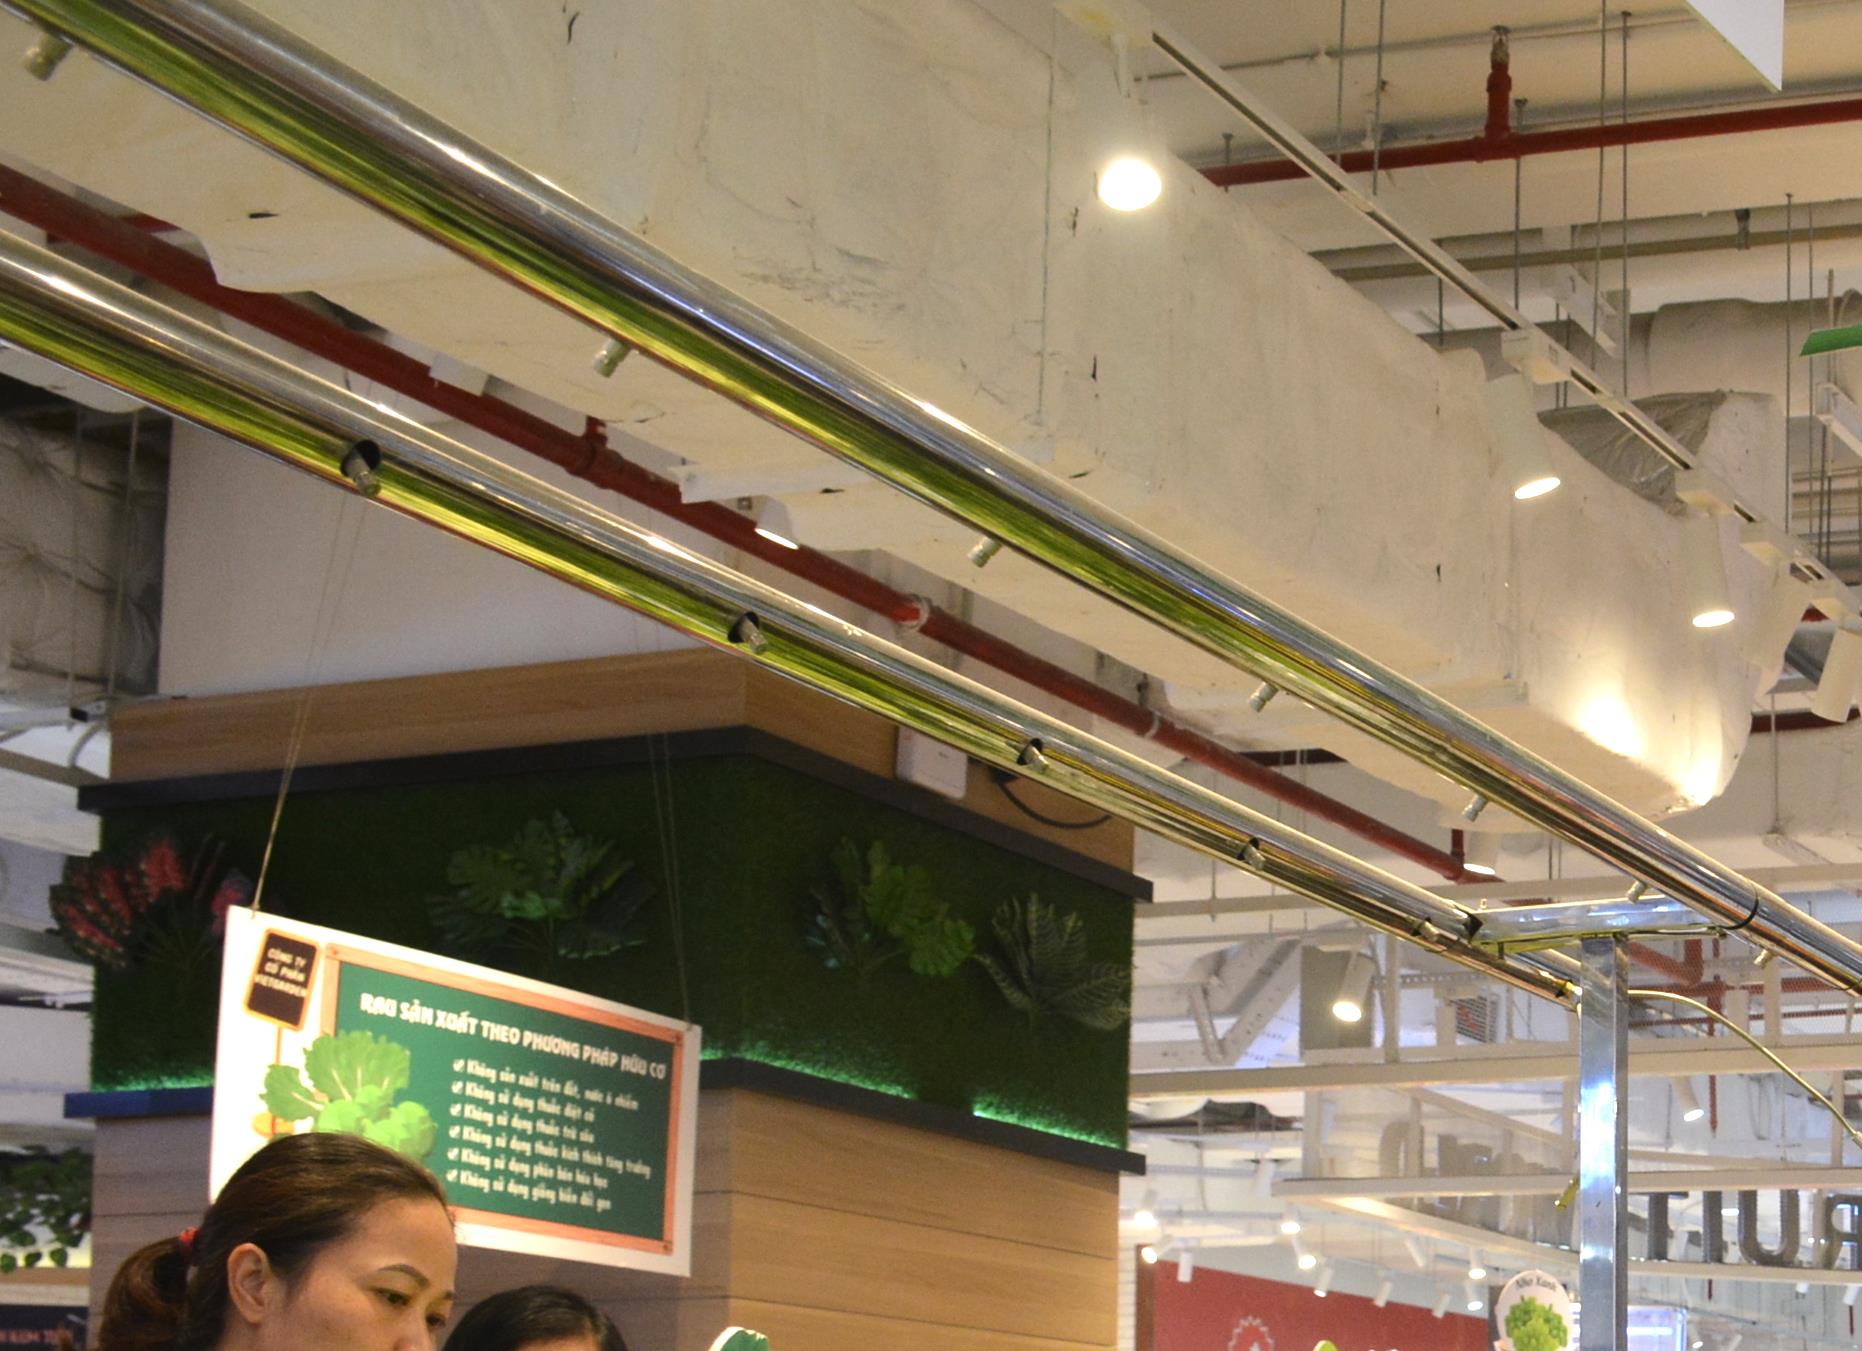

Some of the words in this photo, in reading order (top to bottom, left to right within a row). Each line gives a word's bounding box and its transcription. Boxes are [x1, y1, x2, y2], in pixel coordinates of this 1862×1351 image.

[360, 993, 398, 1017] RAU
[434, 1009, 478, 1037] XUẤT
[480, 1020, 521, 1046] THEO
[582, 1045, 619, 1068] PHÁP
